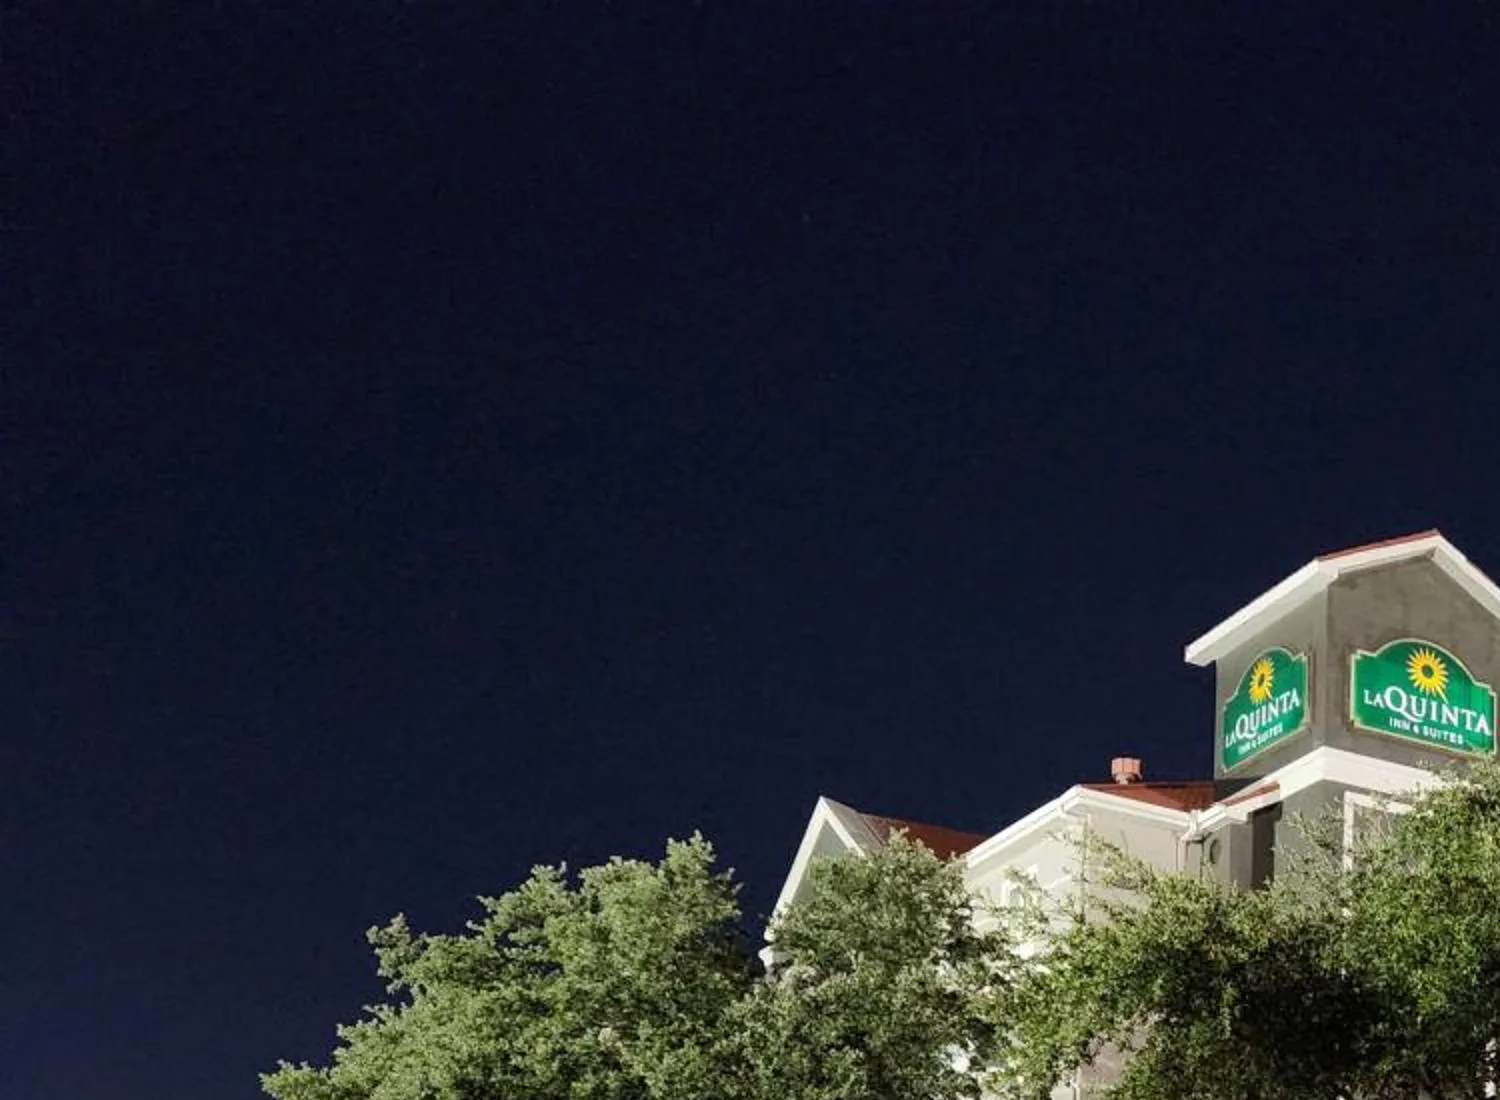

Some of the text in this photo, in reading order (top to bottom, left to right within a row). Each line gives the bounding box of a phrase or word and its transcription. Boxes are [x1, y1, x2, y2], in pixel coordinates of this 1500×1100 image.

[1235, 687, 1300, 739] QUINTA
[1363, 685, 1492, 736] LA QUINTA
[1422, 725, 1463, 745] SUITES
